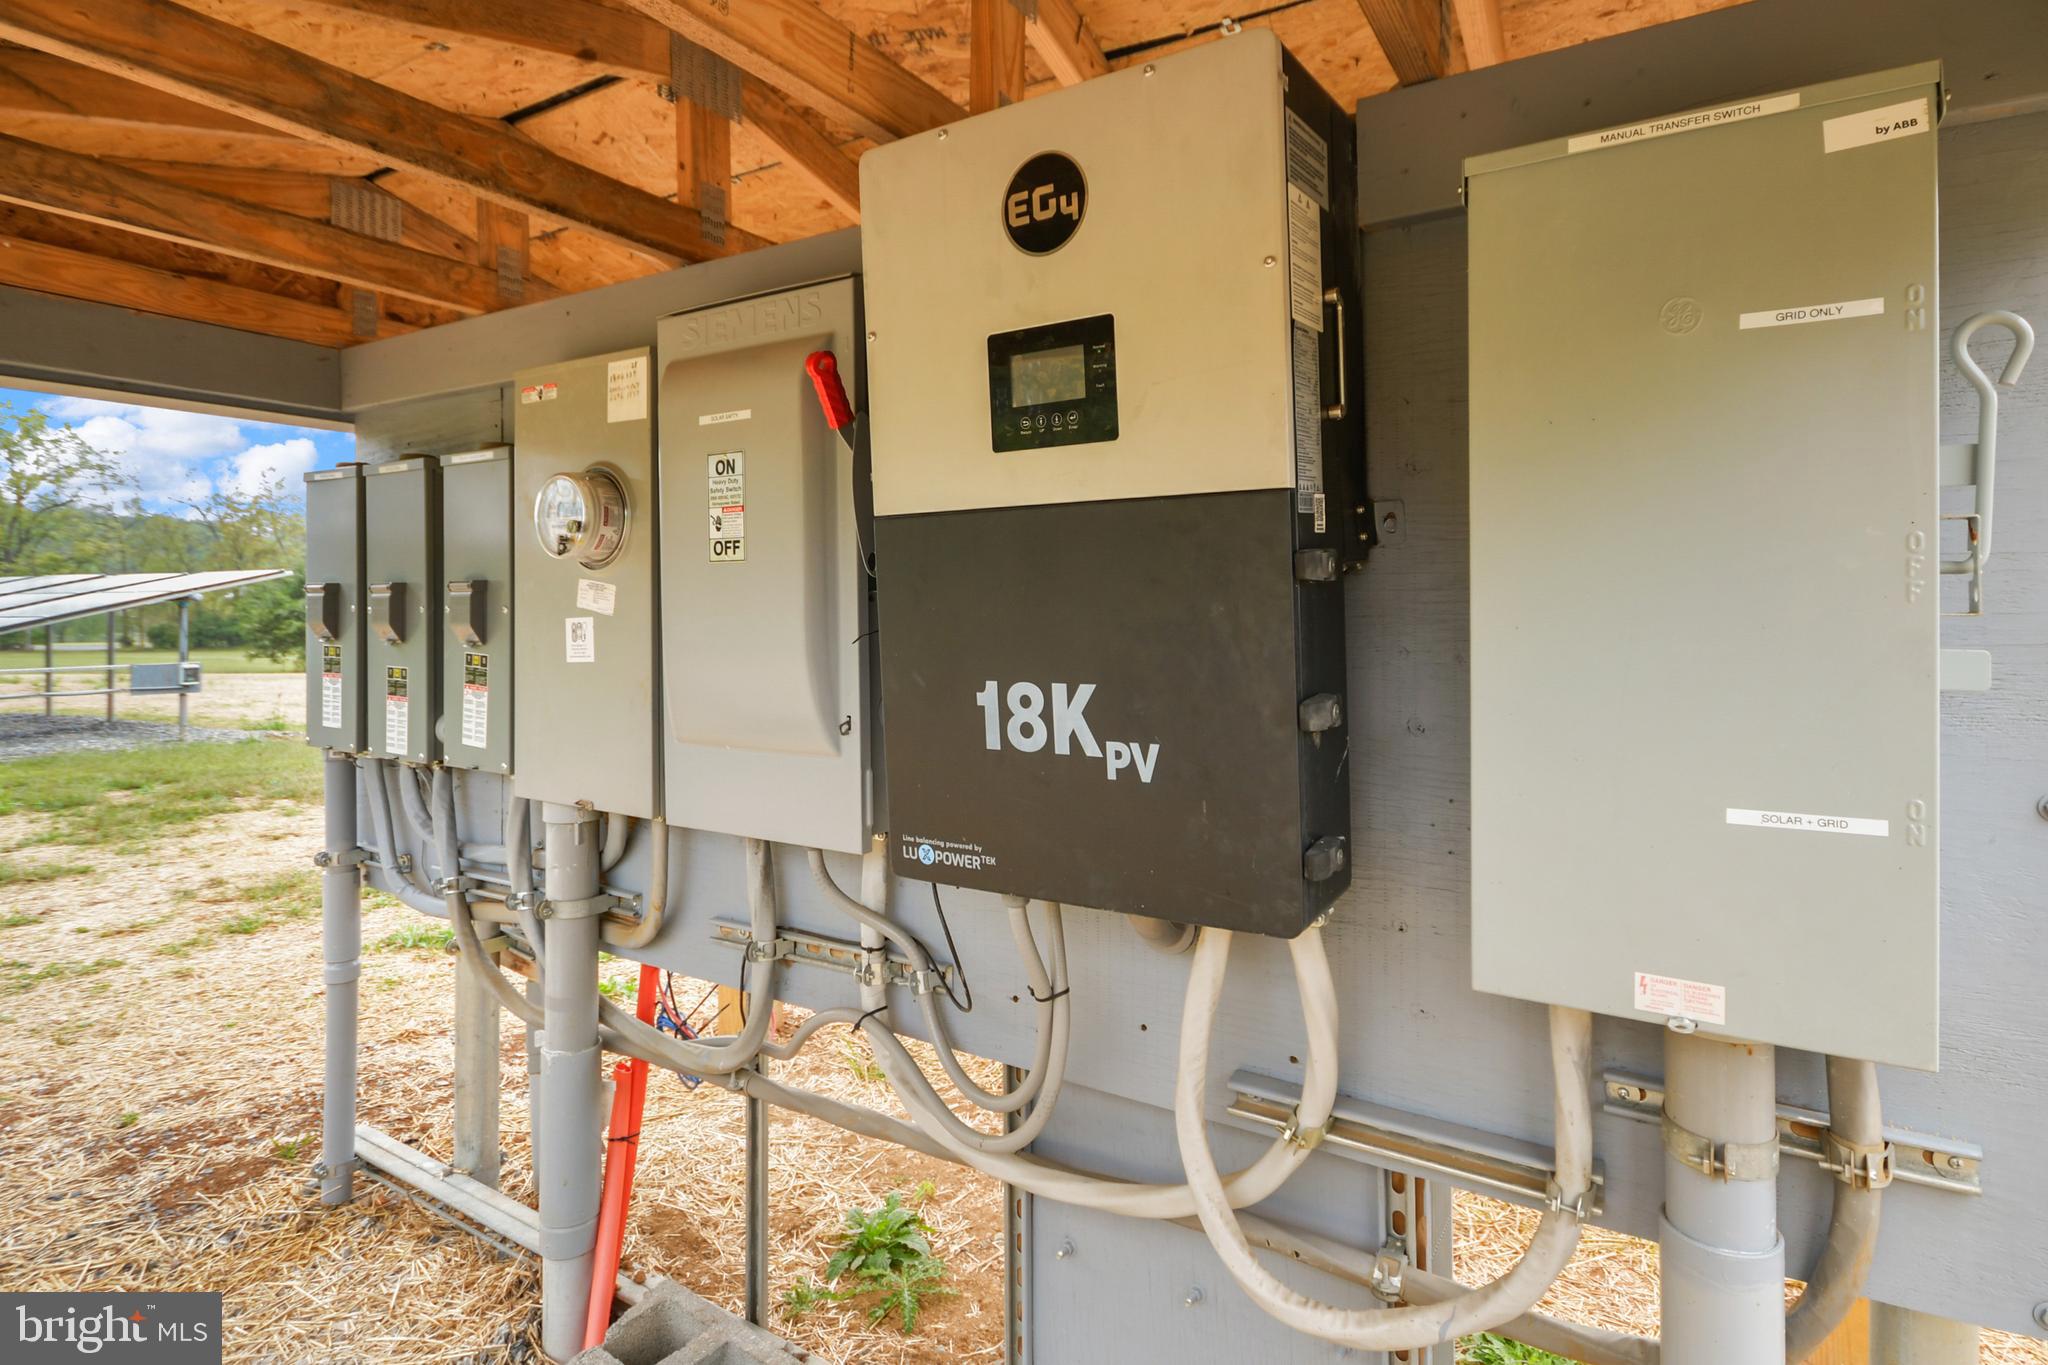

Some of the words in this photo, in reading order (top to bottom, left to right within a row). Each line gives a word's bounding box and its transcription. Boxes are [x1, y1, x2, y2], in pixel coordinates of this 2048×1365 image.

[1600, 127, 1646, 144] MANUAL
[1649, 114, 1711, 133] TRANSFER
[1713, 104, 1761, 121] SWITCH
[1875, 126, 1890, 135] by
[1893, 118, 1918, 131] ABB
[1008, 183, 1079, 228] EG4
[681, 290, 823, 348] SIEMENS
[1775, 310, 1806, 322] GRID
[1809, 306, 1843, 317] ONLY
[715, 459, 735, 475] ON
[714, 540, 741, 556] OFF
[1761, 814, 1803, 826] SOLAR
[1817, 818, 1849, 830] GRID
[1904, 799, 1926, 847] ON
[902, 834, 915, 842] Line
[915, 837, 945, 848] balancing
[945, 841, 973, 851] powered
[974, 844, 982, 853] by
